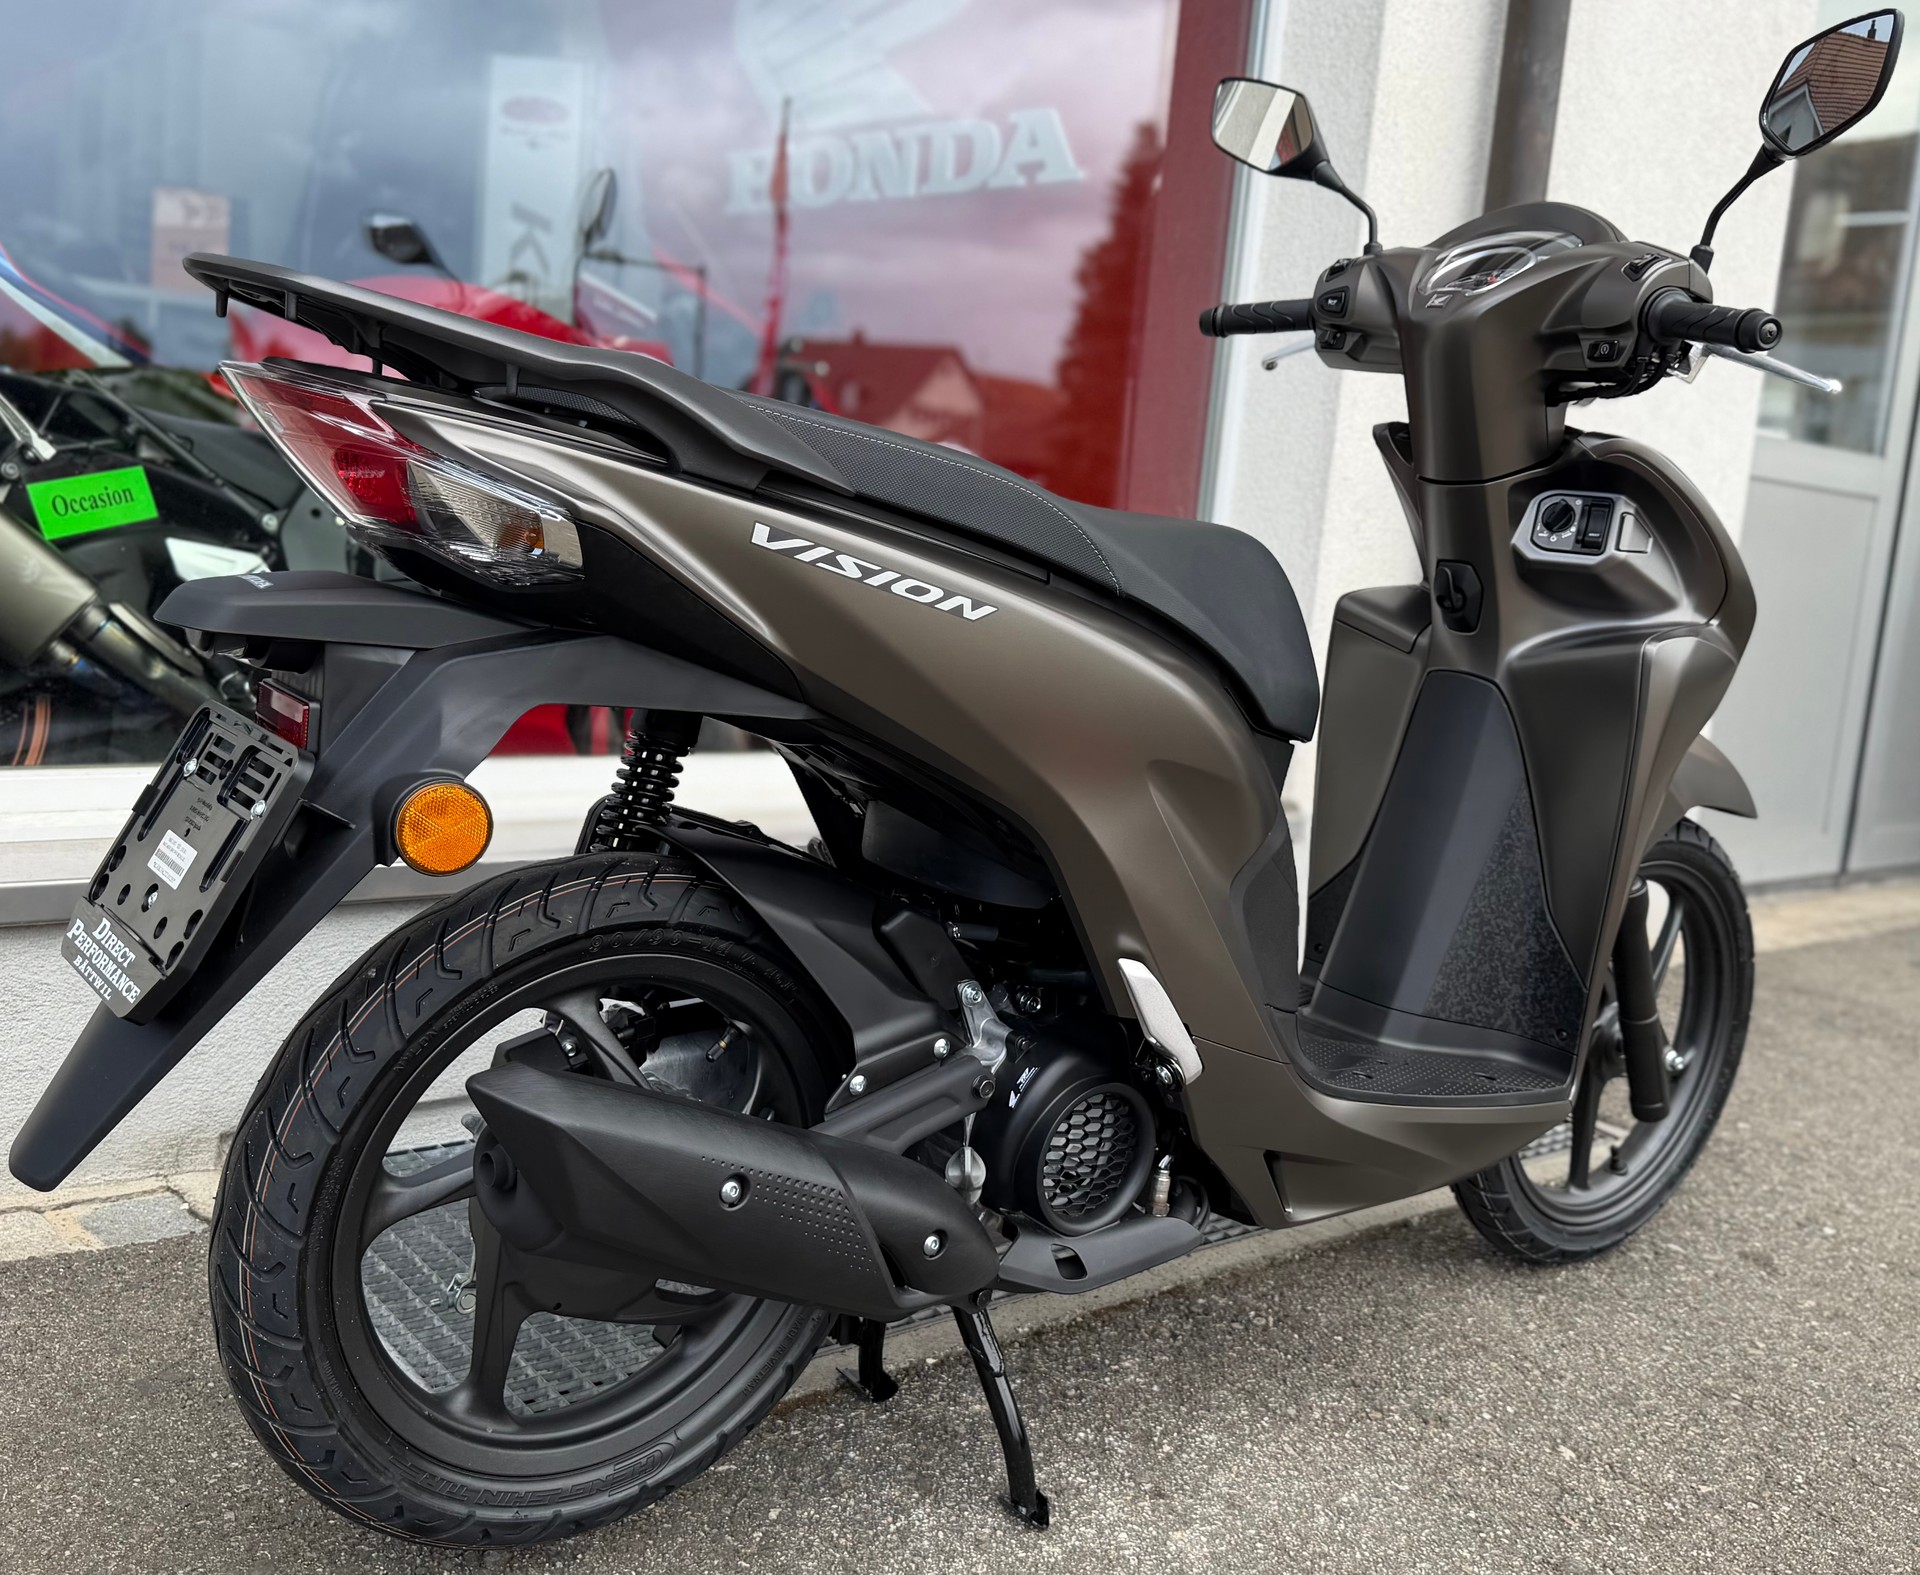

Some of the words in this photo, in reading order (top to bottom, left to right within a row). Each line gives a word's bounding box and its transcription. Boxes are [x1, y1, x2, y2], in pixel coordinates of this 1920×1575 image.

[725, 108, 1083, 216] HONDA
[51, 486, 135, 517] Occasion
[750, 521, 998, 621] VISION
[66, 918, 141, 1004] PERFORMANCE
[92, 917, 136, 968] DIRECT
[73, 954, 112, 1001] BÄTTWIL
